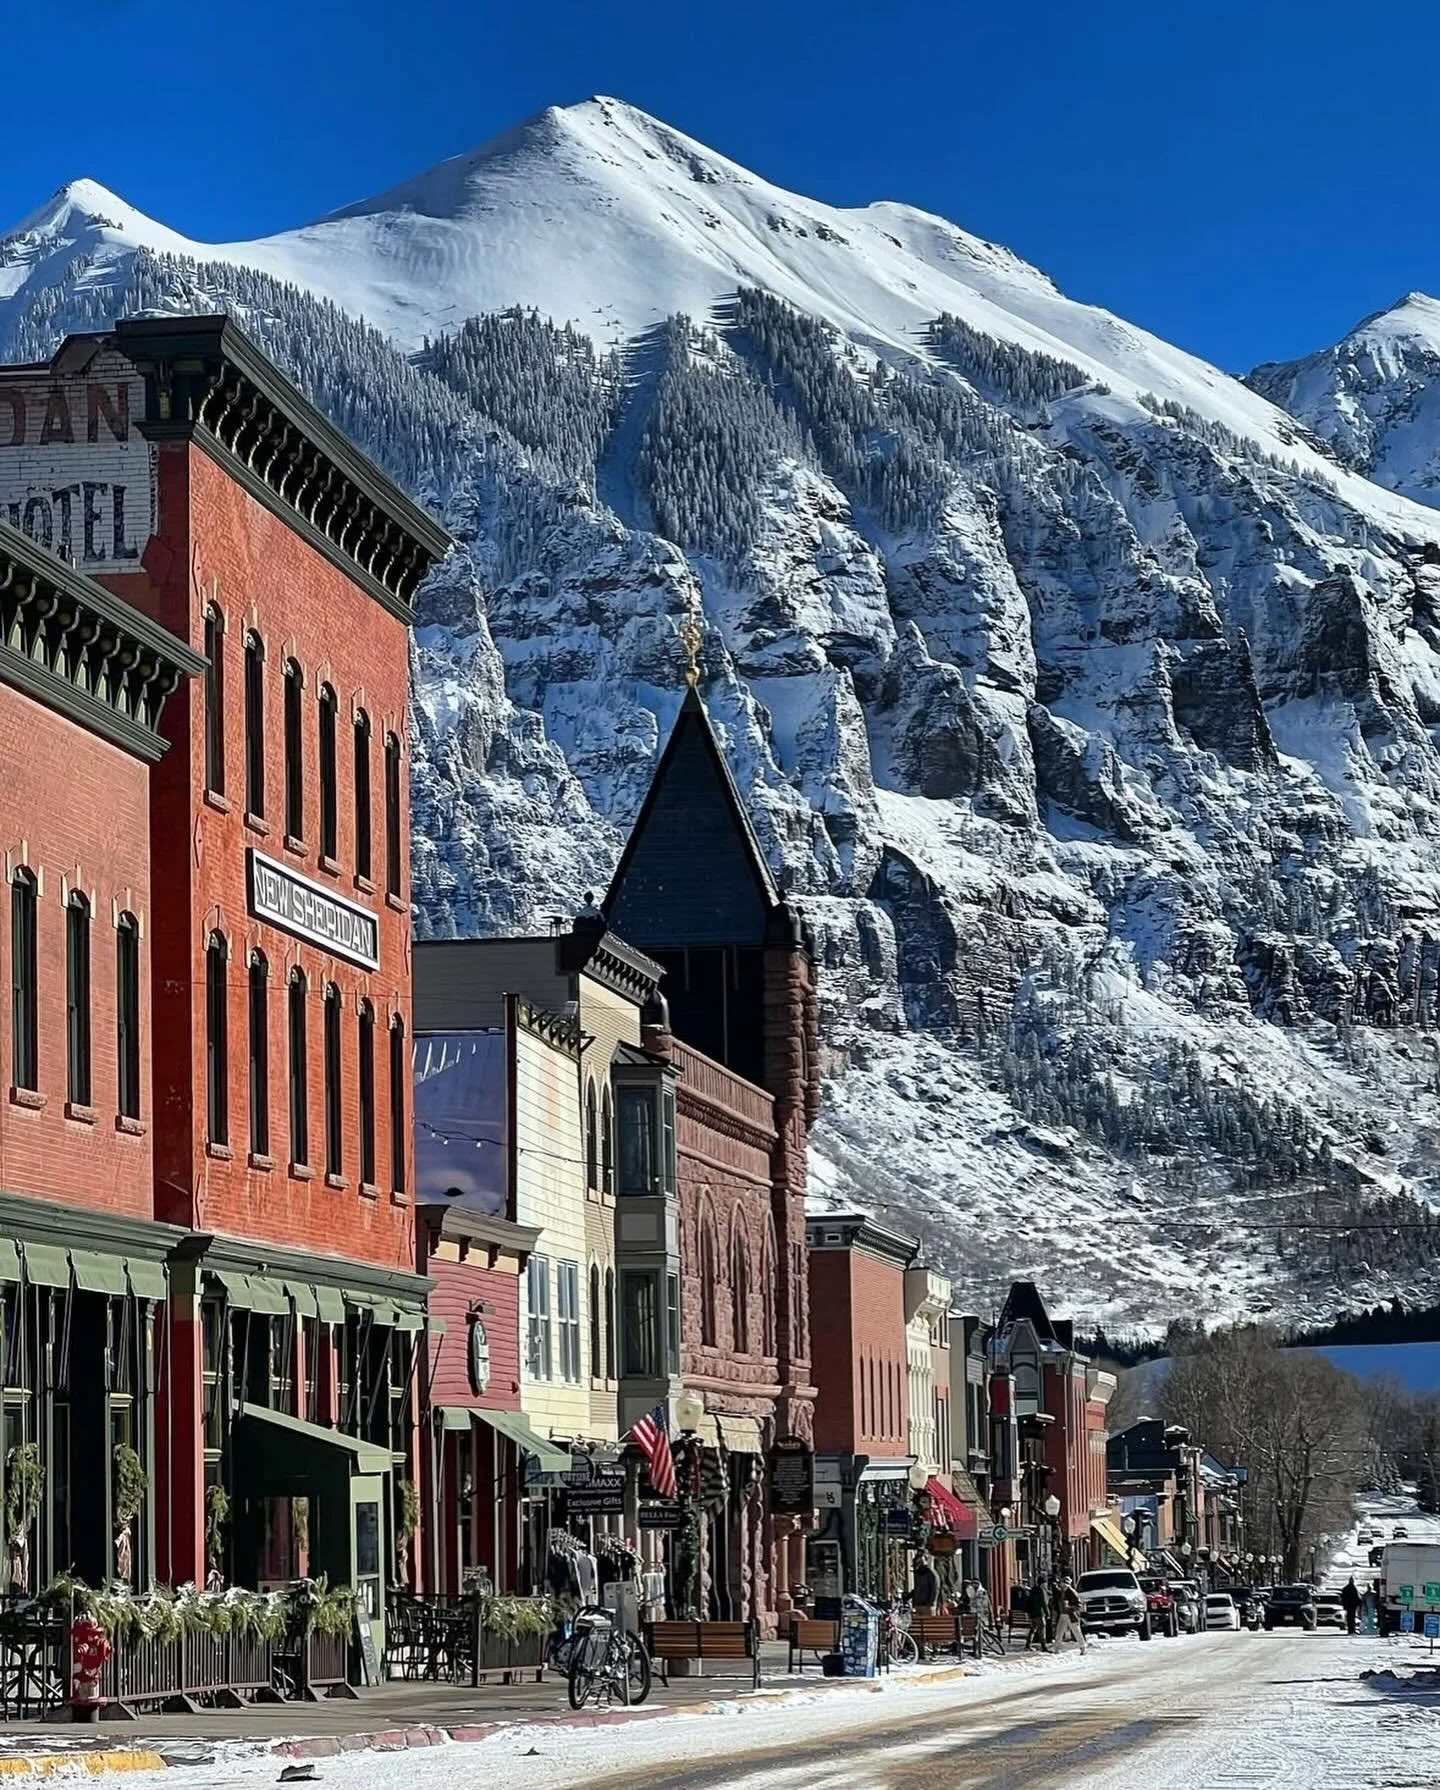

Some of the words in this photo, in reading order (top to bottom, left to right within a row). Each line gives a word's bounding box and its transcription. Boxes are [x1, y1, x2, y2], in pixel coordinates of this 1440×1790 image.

[255, 862, 290, 916] NEW
[292, 883, 374, 959] SHERIDAN
[603, 1496, 622, 1506] Gifts
